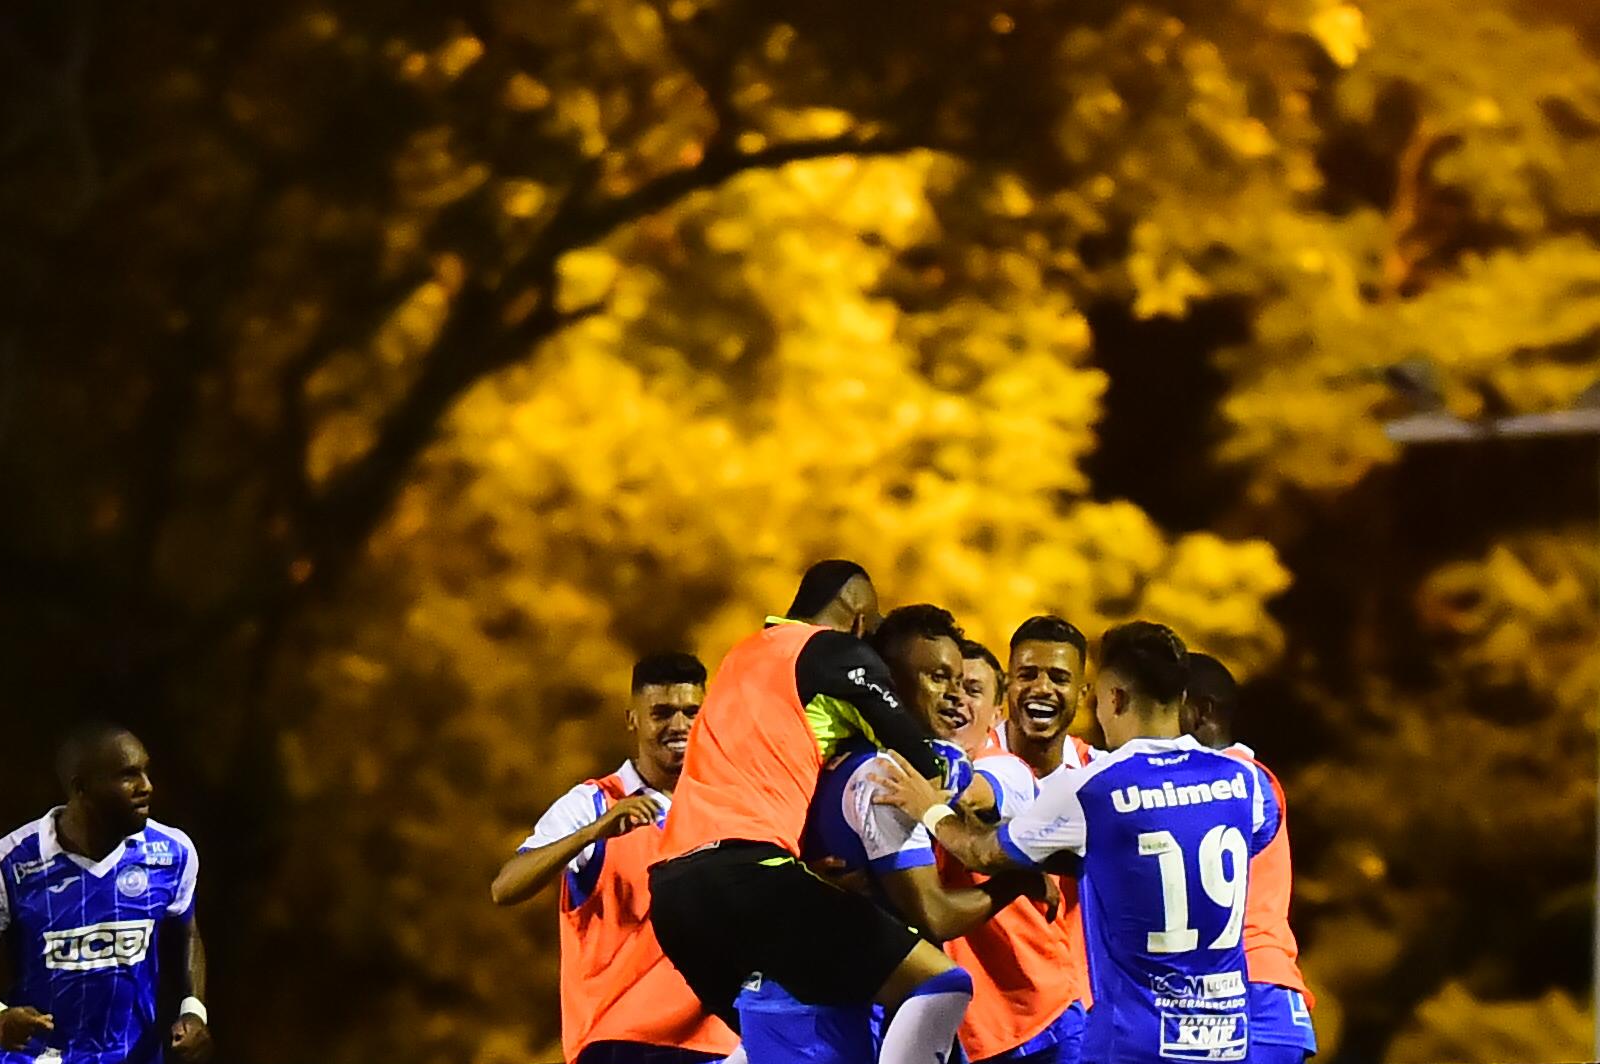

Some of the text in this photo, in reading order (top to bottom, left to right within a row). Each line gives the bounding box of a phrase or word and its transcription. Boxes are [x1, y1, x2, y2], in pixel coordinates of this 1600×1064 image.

[1110, 772, 1248, 813] Unimed
[1138, 823, 1248, 953] 19
[51, 928, 146, 961] JCB
